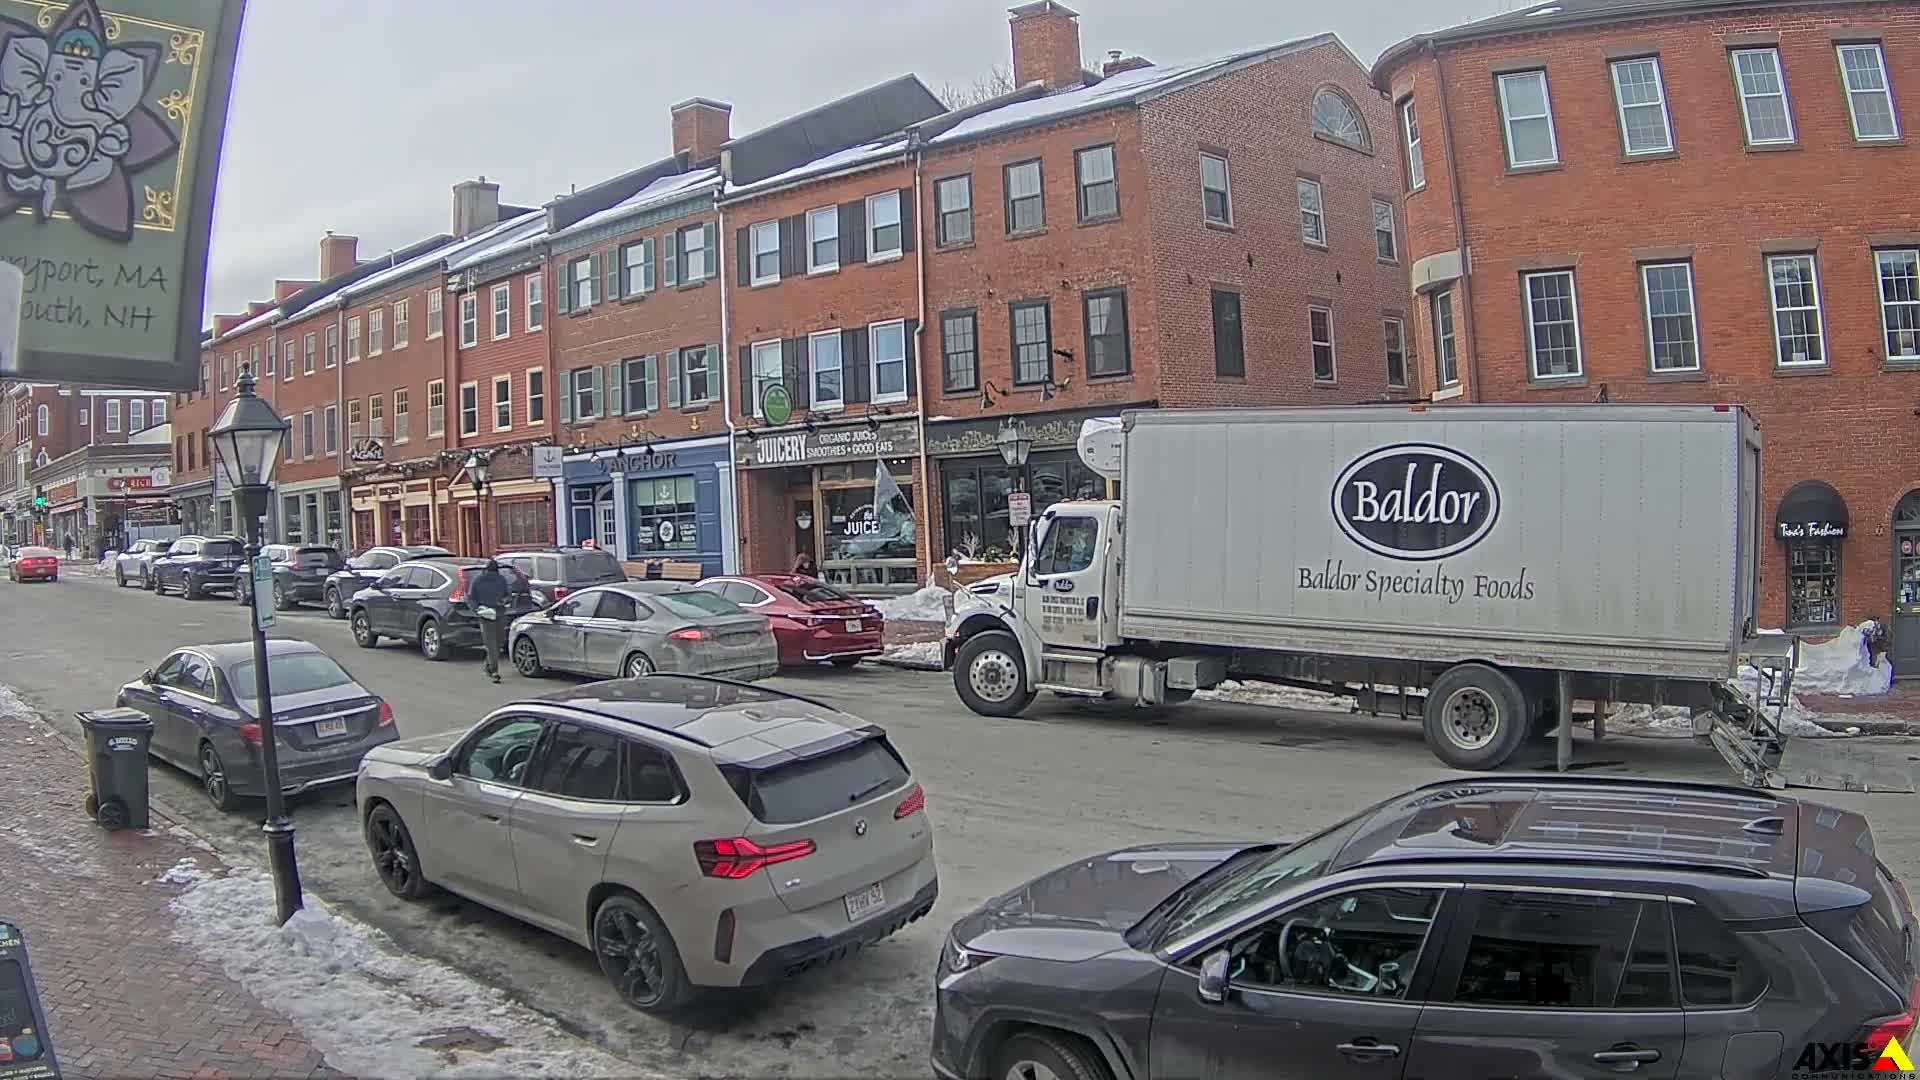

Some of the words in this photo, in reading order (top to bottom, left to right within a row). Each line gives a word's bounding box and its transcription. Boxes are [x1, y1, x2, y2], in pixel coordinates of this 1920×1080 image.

[113, 263, 168, 293] MA
[103, 303, 158, 333] NH
[757, 434, 807, 464] JUICERY
[806, 445, 846, 458] SMOOTHIES
[852, 443, 874, 454] GOOD
[875, 441, 893, 453] EATS
[818, 432, 850, 444] ORGANIC
[851, 429, 877, 442] JUICES
[610, 452, 677, 473] ANCHOR
[1352, 462, 1480, 524] Baldor
[1780, 523, 1804, 537] Tina's
[1297, 559, 1361, 591] Baldor
[1365, 563, 1465, 604] Specialty
[1473, 567, 1536, 600] Foods
